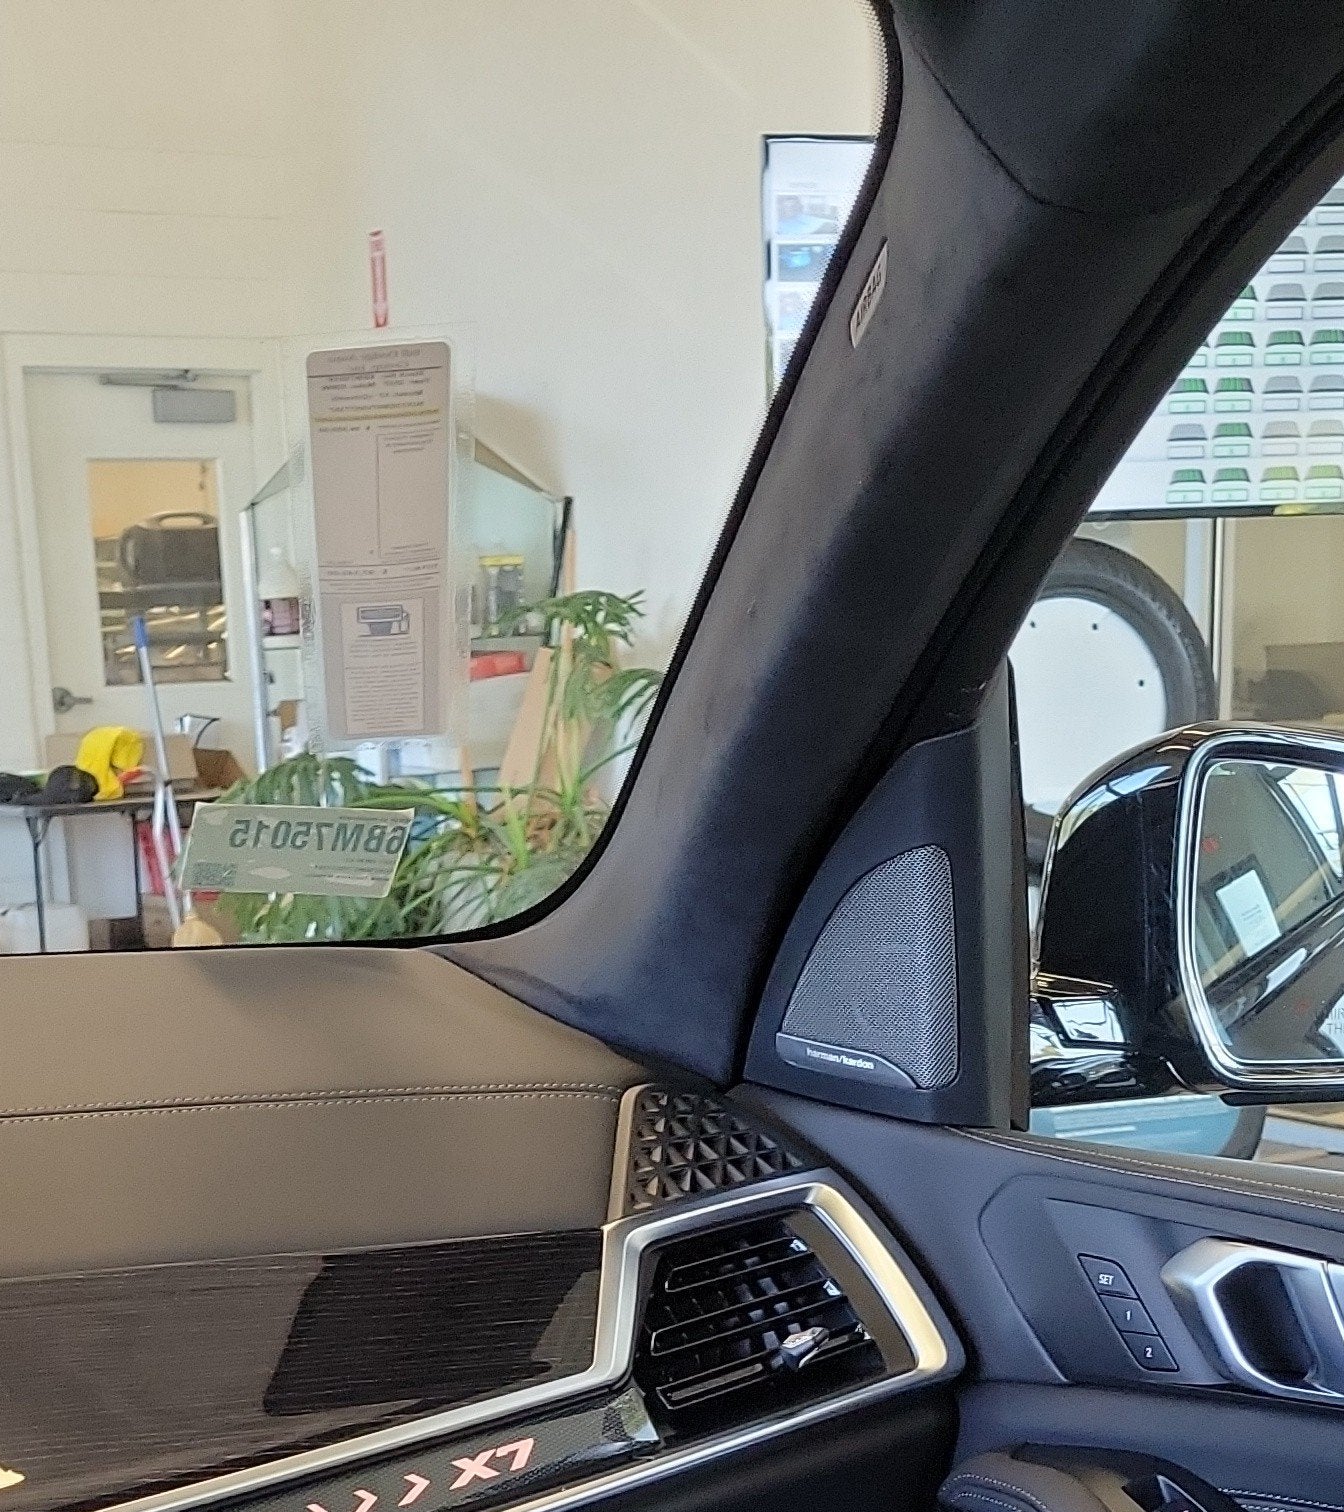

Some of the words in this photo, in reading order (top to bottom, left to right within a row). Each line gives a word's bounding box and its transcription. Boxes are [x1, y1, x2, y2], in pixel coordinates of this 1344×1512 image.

[1098, 1273, 1115, 1286] SET
[1125, 1310, 1132, 1321] 1
[1145, 1347, 1153, 1358] 2
[449, 1437, 535, 1491] X7
